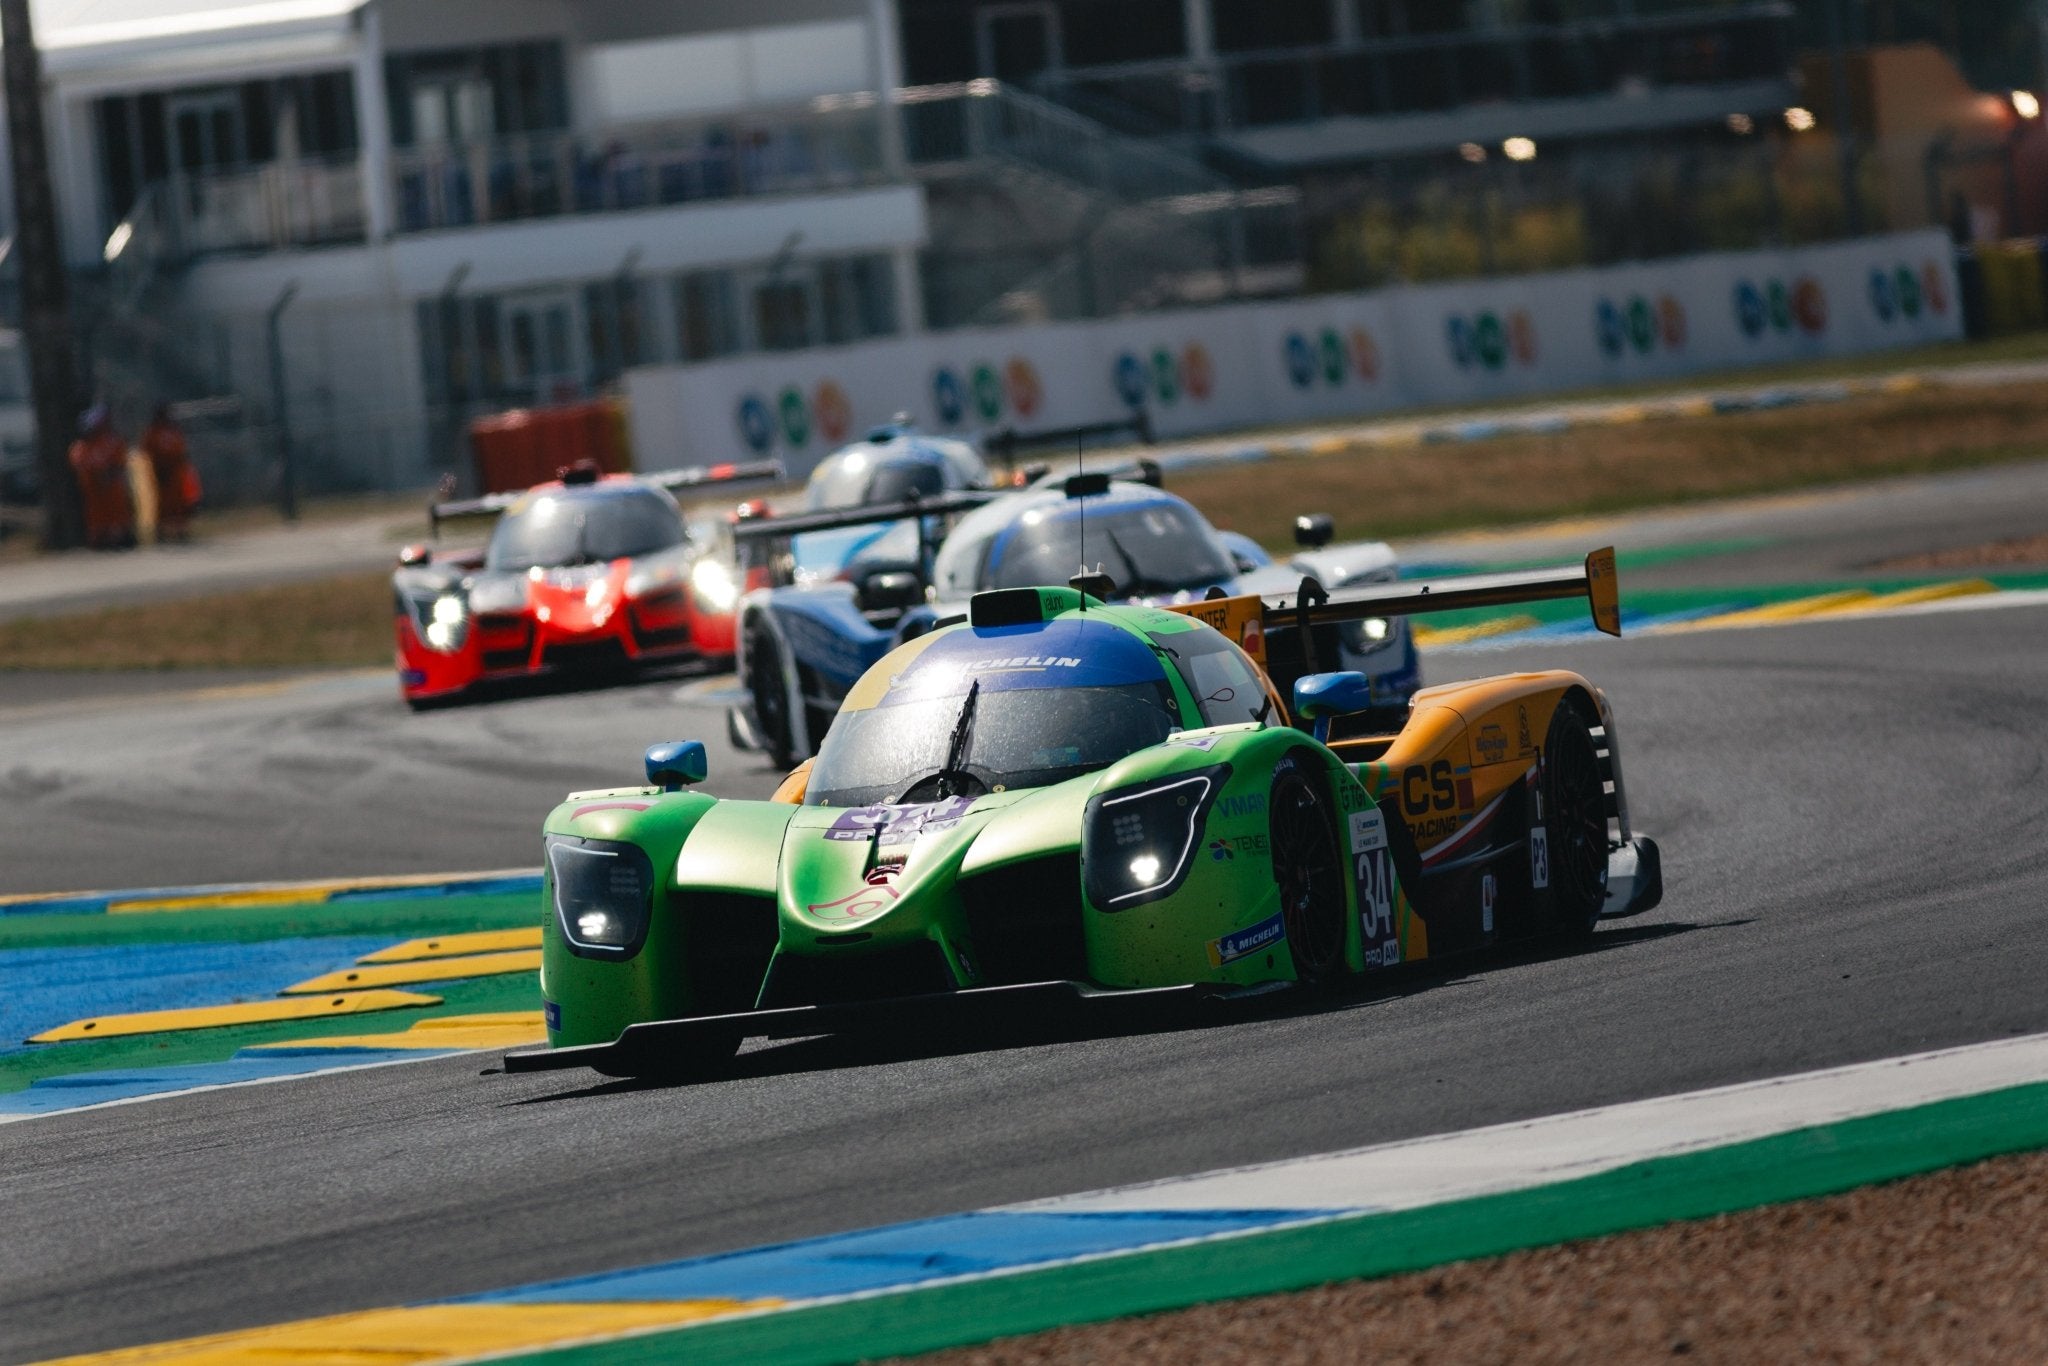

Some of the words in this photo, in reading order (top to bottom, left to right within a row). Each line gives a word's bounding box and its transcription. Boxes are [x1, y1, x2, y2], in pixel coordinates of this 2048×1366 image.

[1403, 759, 1456, 816] CS
[1533, 837, 1547, 881] P3
[1358, 850, 1391, 938] 34
[1240, 923, 1280, 950] MICHELIN
[1366, 948, 1382, 967] PRO
[1384, 943, 1398, 963] AM
